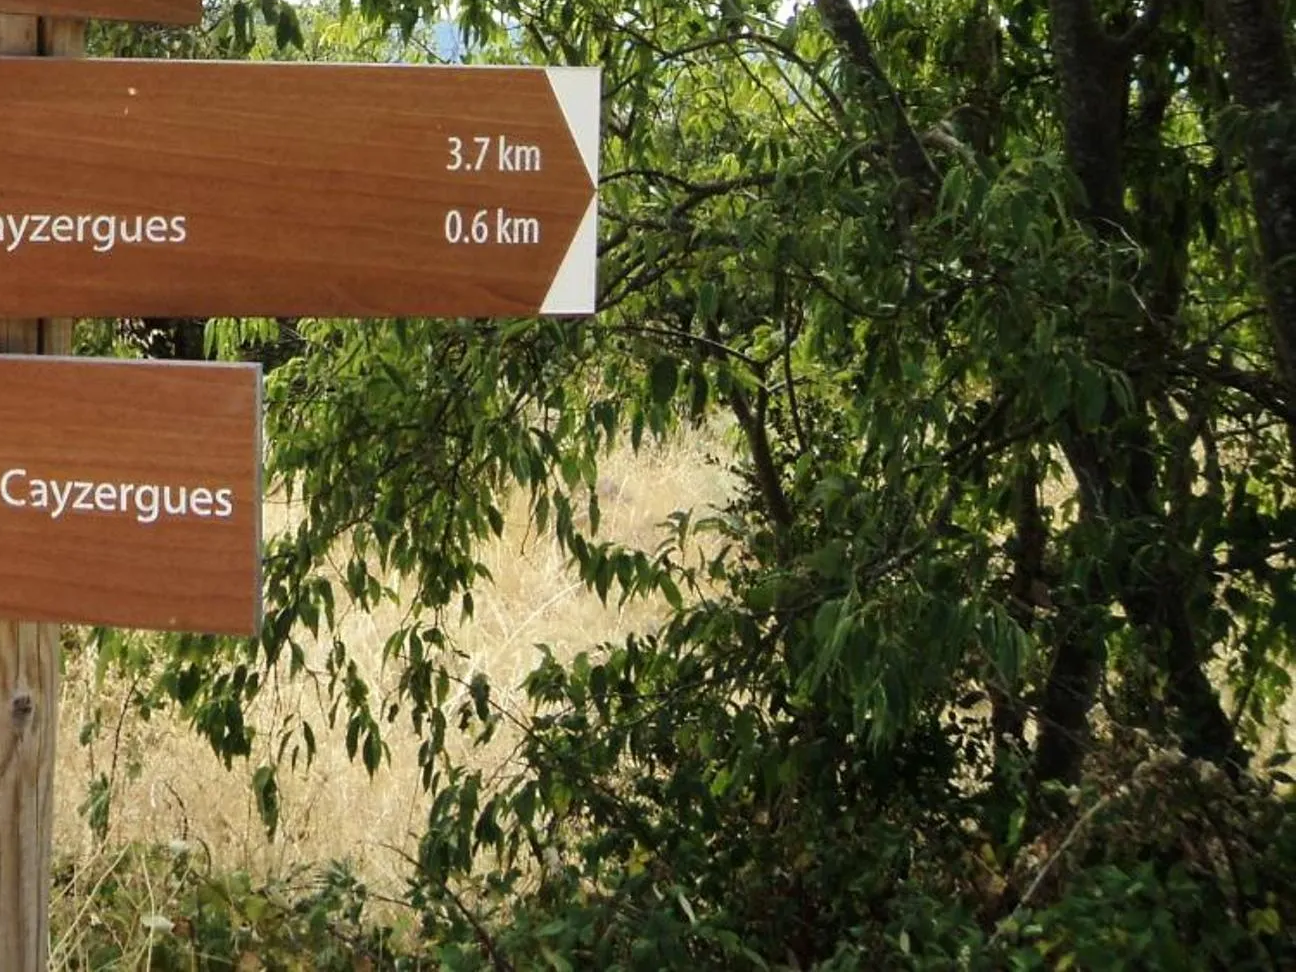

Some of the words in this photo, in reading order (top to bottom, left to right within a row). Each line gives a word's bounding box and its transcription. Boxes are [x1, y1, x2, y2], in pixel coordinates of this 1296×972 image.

[446, 136, 490, 171] 3.7
[498, 135, 541, 171] km
[445, 209, 488, 244] 0.6
[496, 208, 539, 244] km
[0, 468, 232, 523] Cayzergues
